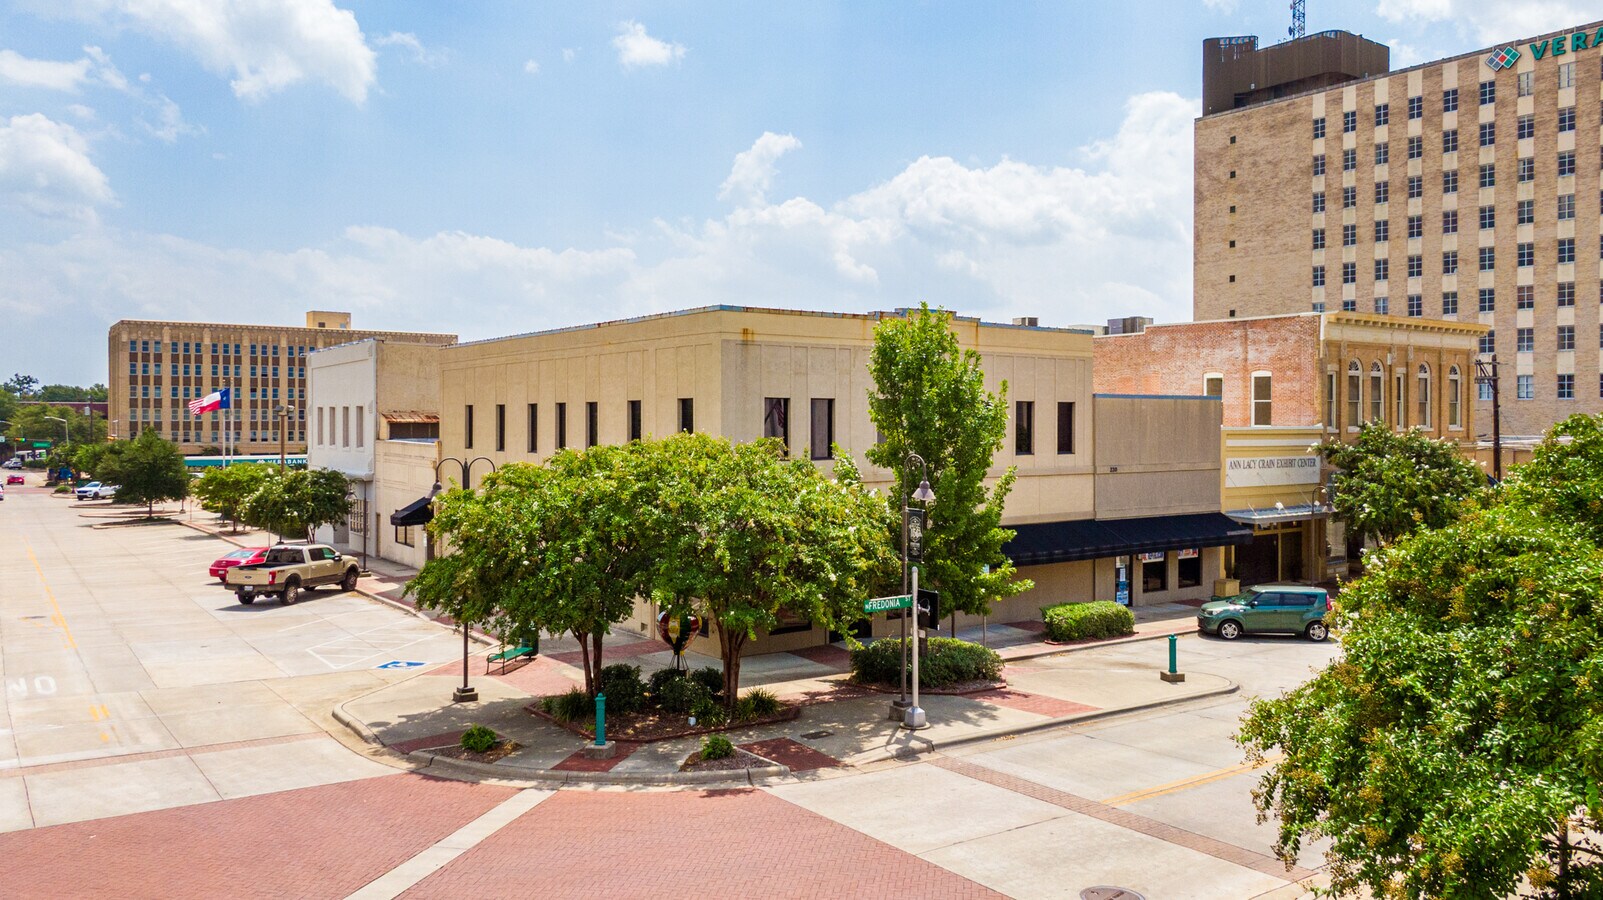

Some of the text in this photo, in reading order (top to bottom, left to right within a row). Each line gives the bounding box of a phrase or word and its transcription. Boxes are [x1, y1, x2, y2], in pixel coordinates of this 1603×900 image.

[1229, 457, 1316, 470] ANN LACY CRAIN EXHIBIT CENTER
[868, 599, 900, 610] FREDONIA
[7, 675, 57, 696] NO
